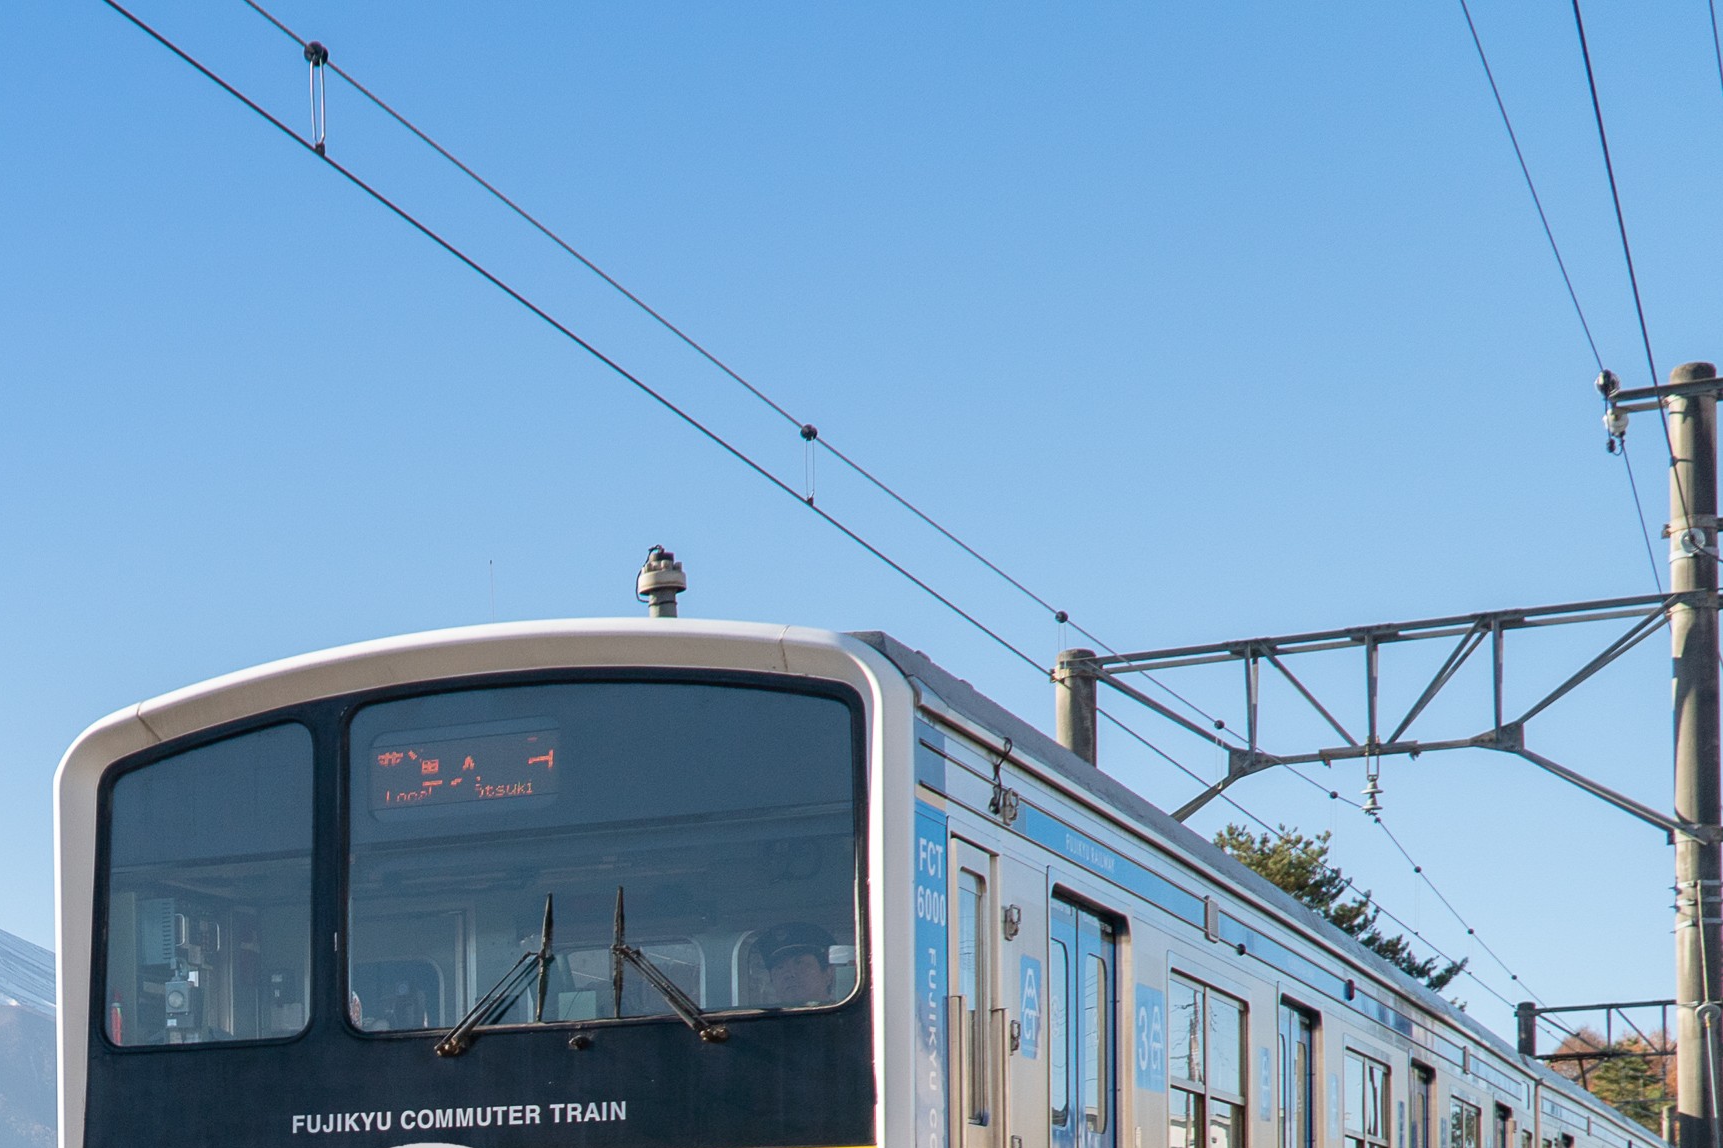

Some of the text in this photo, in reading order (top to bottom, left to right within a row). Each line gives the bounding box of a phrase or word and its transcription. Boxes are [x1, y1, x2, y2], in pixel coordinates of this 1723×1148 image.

[919, 837, 943, 879] FCT
[917, 885, 946, 928] 6000
[928, 947, 937, 1091] FUJIKYU
[291, 1100, 627, 1135] FUJIKYU COMMUTER TRAIN
